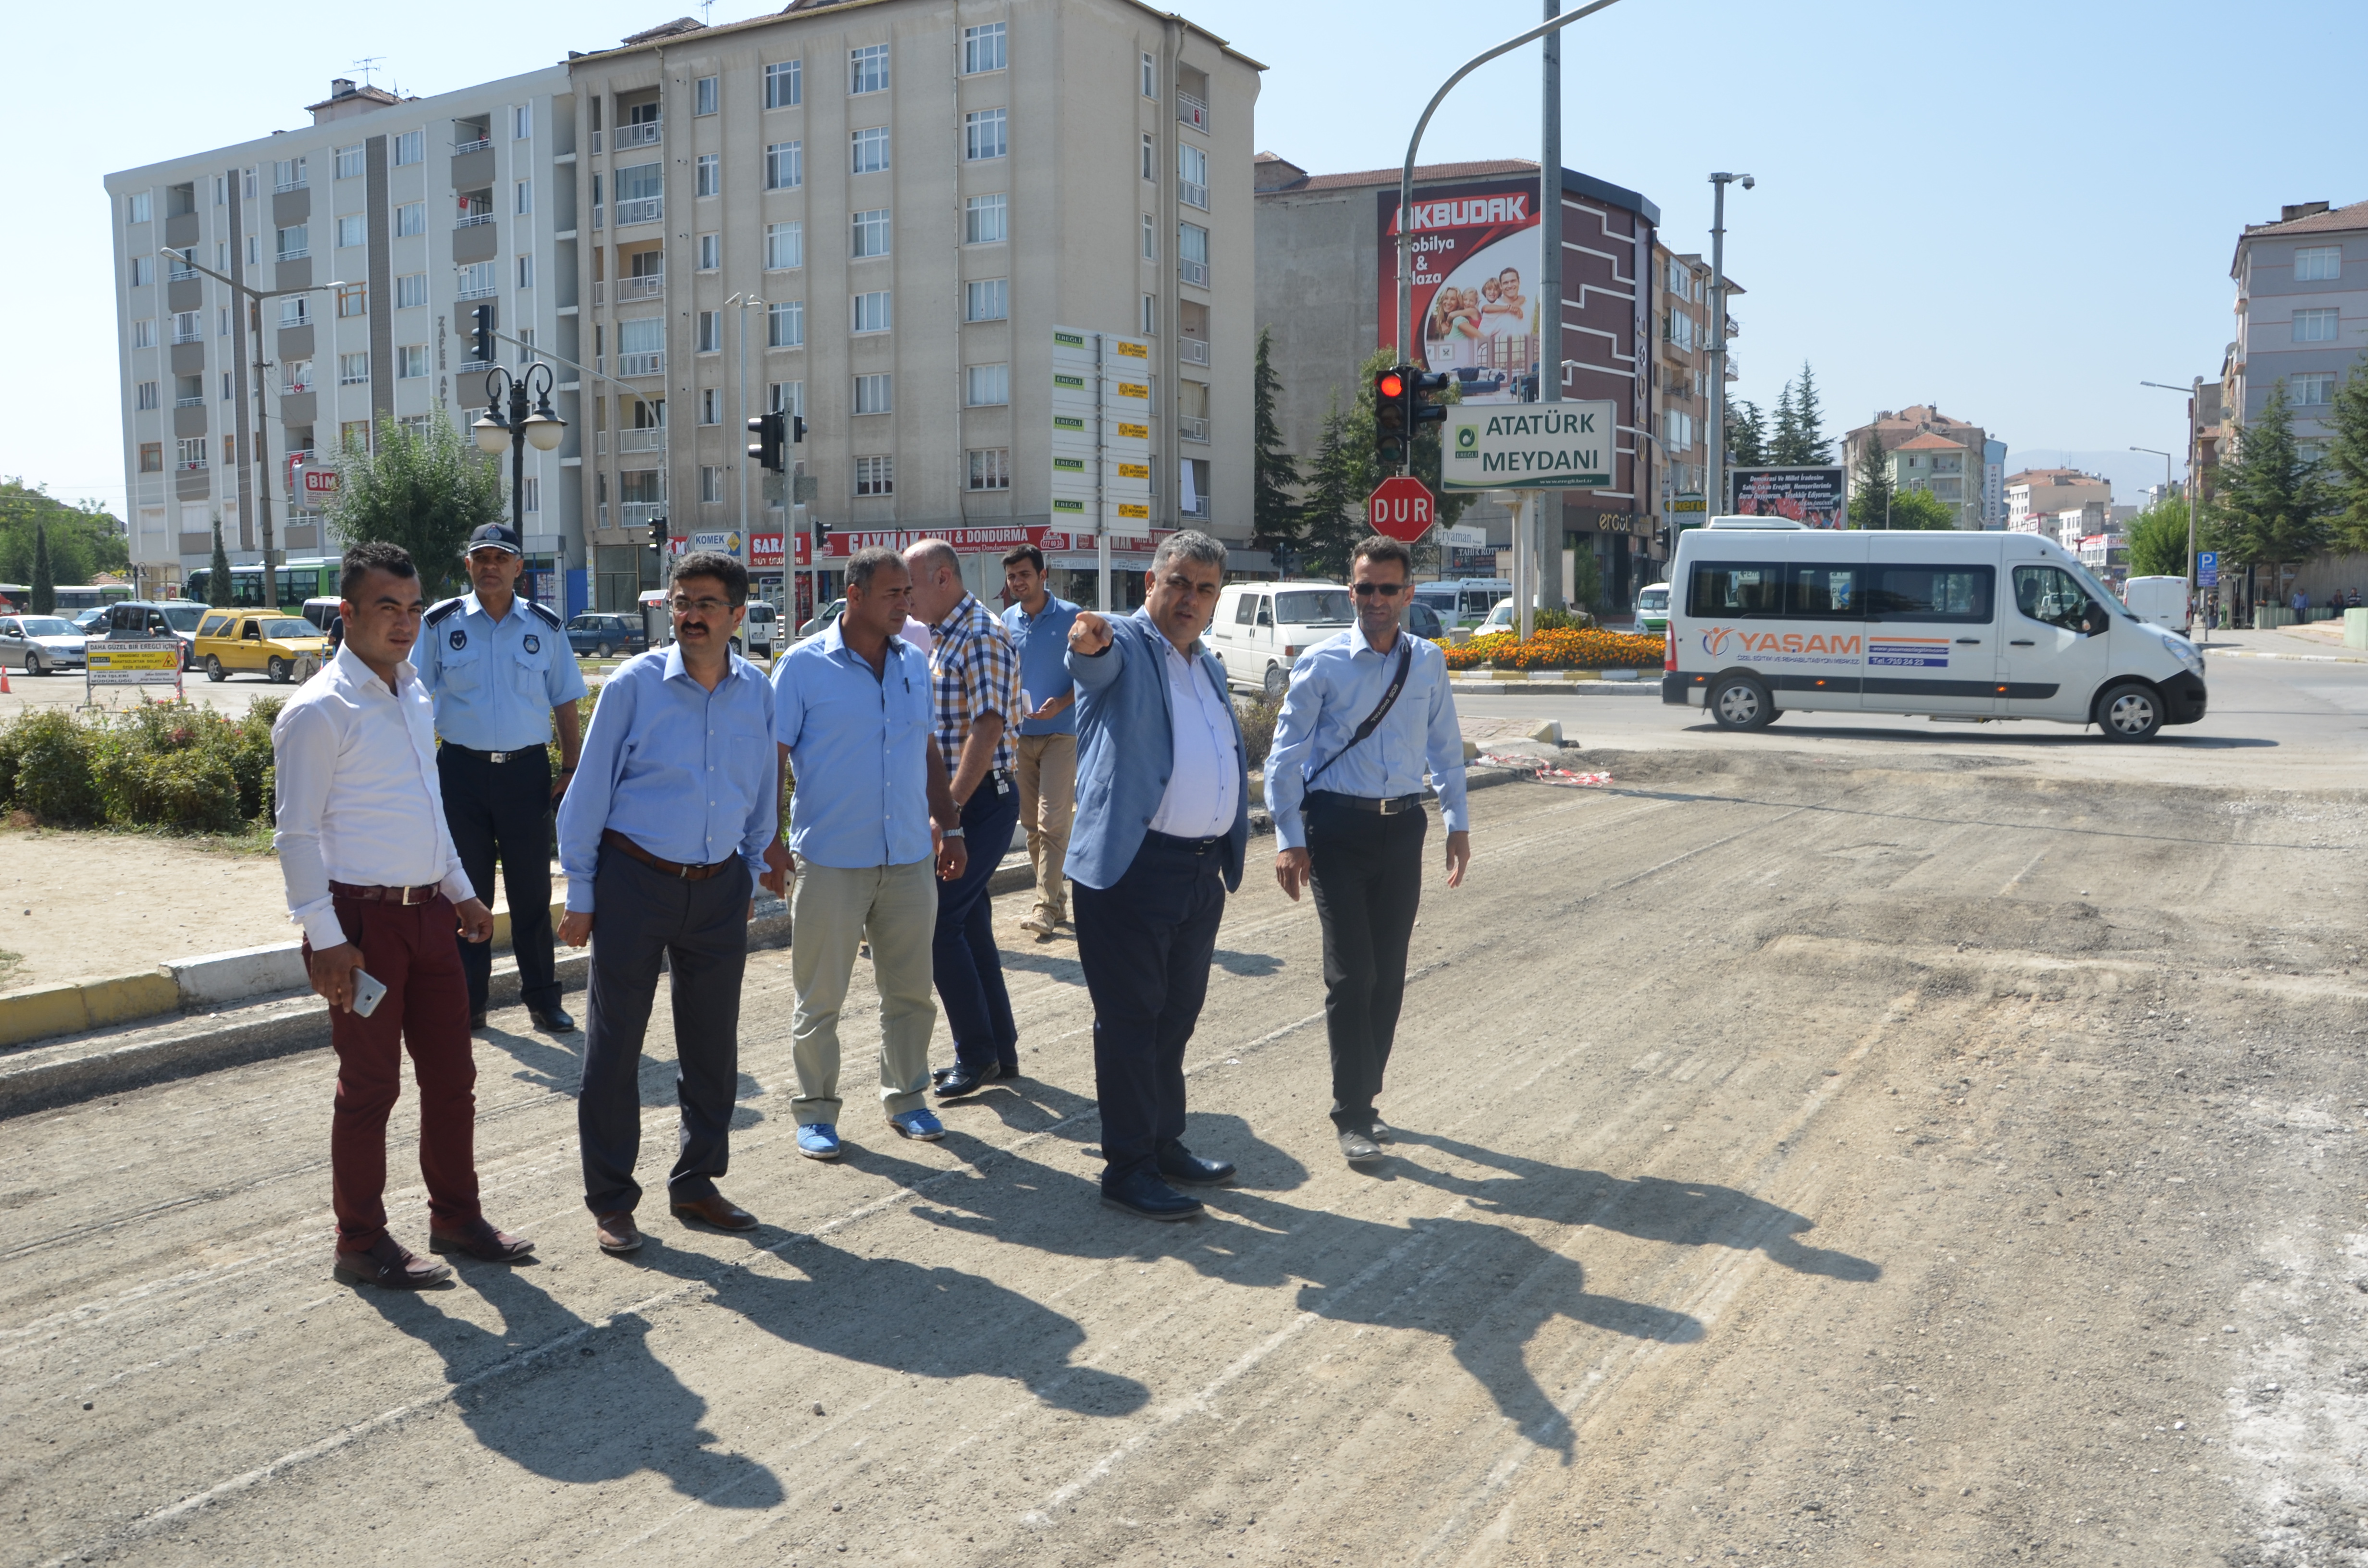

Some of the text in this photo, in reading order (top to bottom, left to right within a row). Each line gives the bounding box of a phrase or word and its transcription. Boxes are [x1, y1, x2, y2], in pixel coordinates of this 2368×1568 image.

[1411, 235, 1455, 254] obilya
[1416, 256, 1428, 270] &
[1412, 271, 1441, 285] laza
[1486, 409, 1594, 436] ATATÜRK
[1483, 450, 1597, 471] MEYDANI
[1375, 498, 1428, 523] DUR
[696, 535, 724, 545] KOMEK
[955, 530, 963, 543] &
[967, 528, 1028, 543] DONDURMA
[1436, 528, 1471, 545] Eryaman
[753, 538, 802, 553] SARAI
[2202, 554, 2212, 568] P
[1738, 633, 1861, 654] YAŞAM
[1370, 684, 1399, 722] EOS DIGITAL
